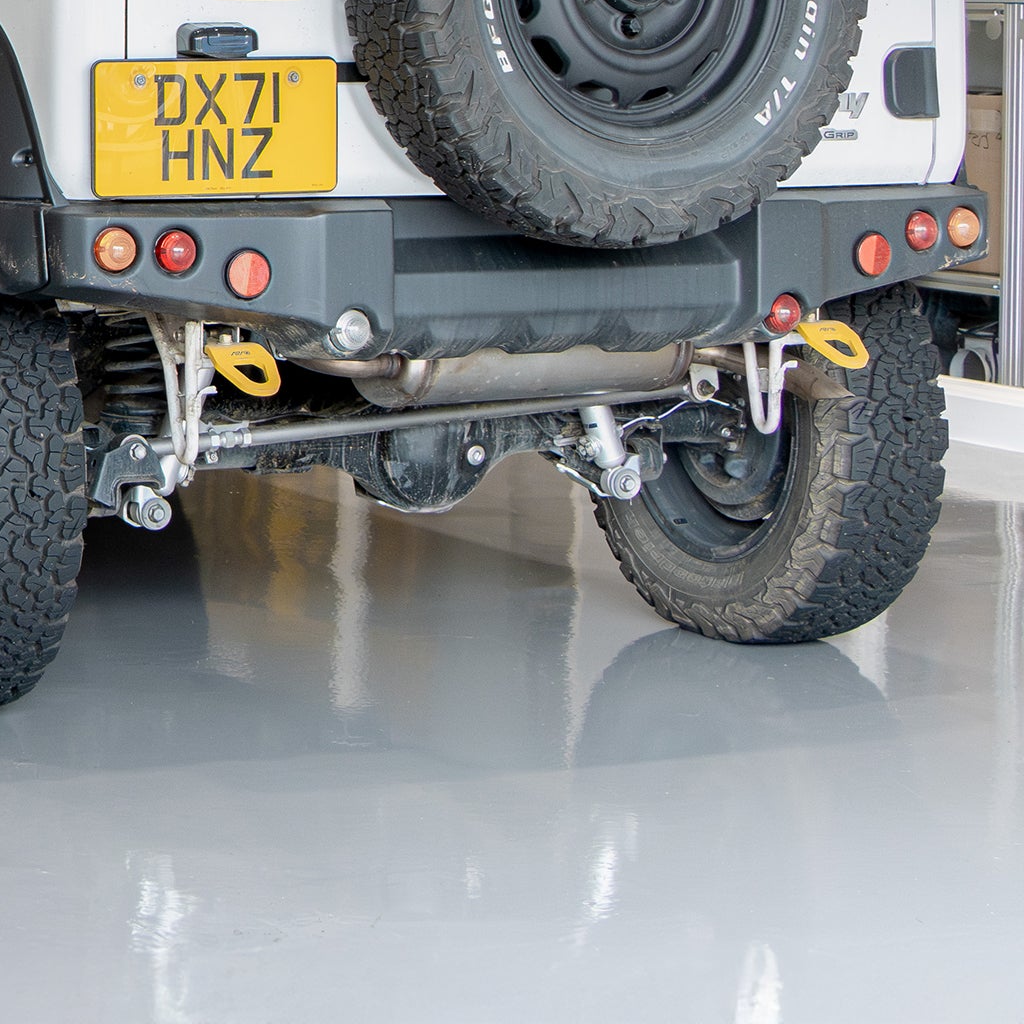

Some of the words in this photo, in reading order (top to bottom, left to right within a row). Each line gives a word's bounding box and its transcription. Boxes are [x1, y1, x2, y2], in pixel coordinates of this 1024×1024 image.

[154, 72, 280, 126] DX71
[754, 76, 797, 127] T/A
[161, 127, 273, 181] HNZ
